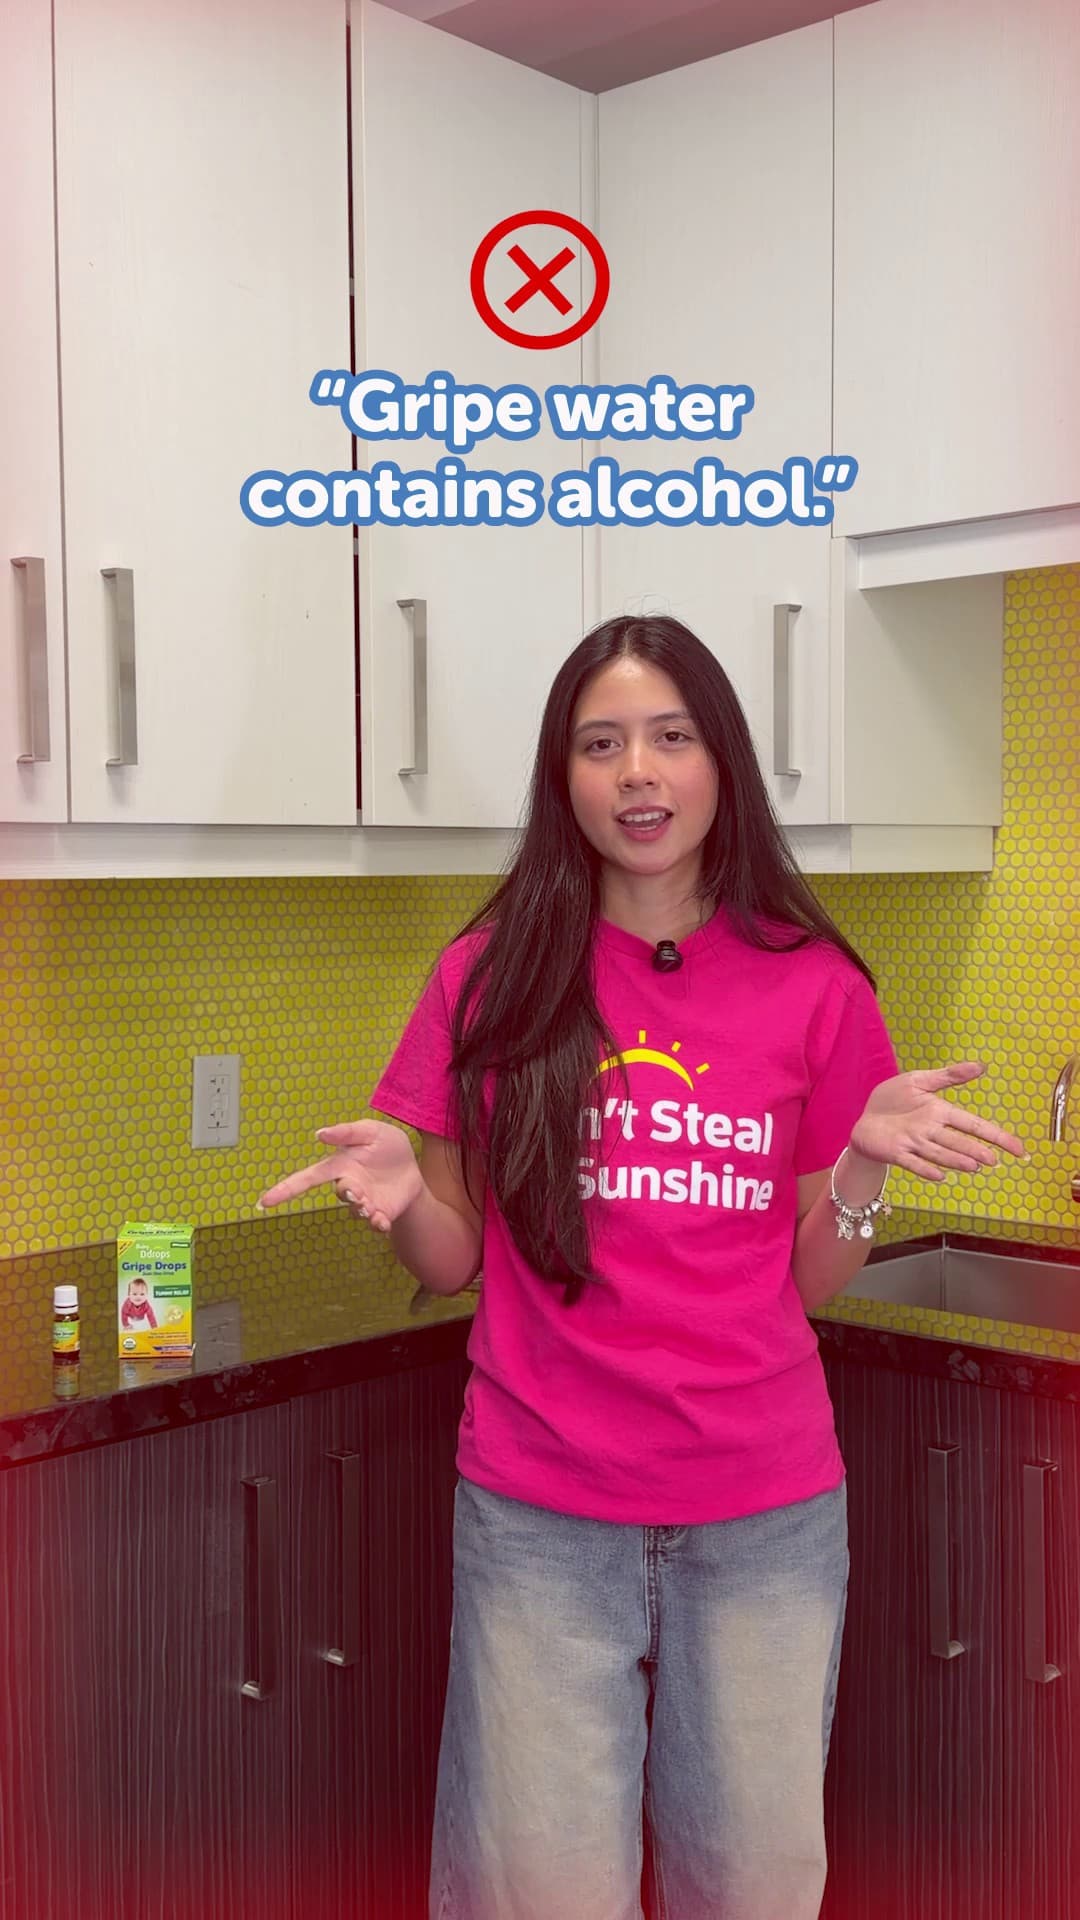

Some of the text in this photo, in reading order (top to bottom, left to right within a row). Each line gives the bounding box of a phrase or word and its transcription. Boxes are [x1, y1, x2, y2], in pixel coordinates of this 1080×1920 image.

[650, 1100, 774, 1155] Steal
[578, 1157, 774, 1211] Sunshine
[122, 1261, 187, 1273] Gripe Drops
